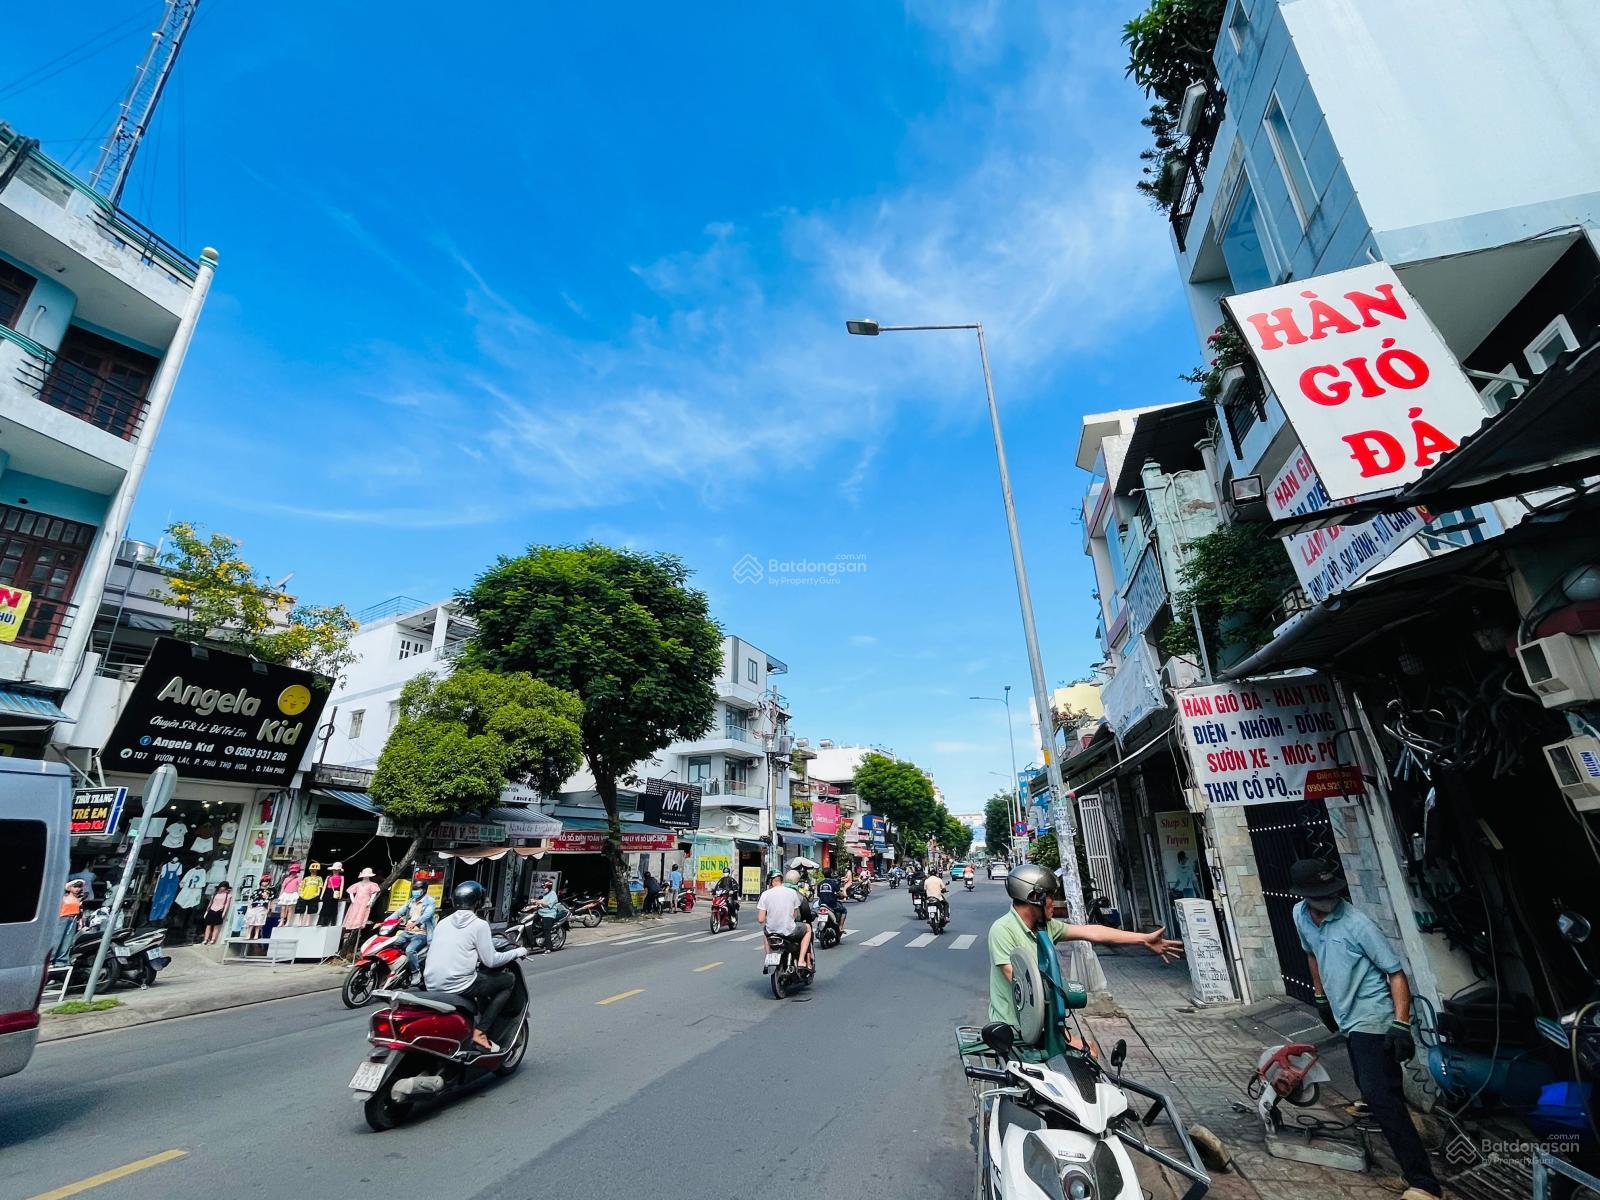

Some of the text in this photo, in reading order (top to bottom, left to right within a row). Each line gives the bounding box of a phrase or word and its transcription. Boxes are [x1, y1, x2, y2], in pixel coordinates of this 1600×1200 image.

[1247, 284, 1407, 350] HÀN
[1299, 337, 1430, 406] GIÓ
[1341, 407, 1460, 478] ĐÁ
[1274, 469, 1300, 510] HÀN
[1296, 453, 1313, 481] GI
[157, 676, 261, 716] Angela
[1182, 694, 1213, 718] HÀN
[1214, 690, 1240, 714] GIÓ
[1240, 687, 1263, 711] ĐÁ
[1305, 684, 1331, 704] TIG
[152, 737, 215, 753] Angela Kid
[234, 728, 247, 737] Em
[256, 718, 303, 746] Kid
[1193, 721, 1228, 748] ĐIỆN
[1239, 715, 1284, 740] NHÔM
[134, 751, 149, 760] 107
[234, 746, 256, 758] 0363
[256, 749, 272, 760] 931
[1207, 747, 1248, 773] SƯỜN
[1249, 748, 1271, 769] XE
[1280, 740, 1317, 766] MÓC
[90, 794, 114, 804] TRANG
[662, 790, 689, 812] NAY
[1204, 779, 1240, 804] THAY
[1243, 771, 1264, 800] CỔ
[91, 808, 108, 819] EM
[700, 857, 717, 870] BÚN
